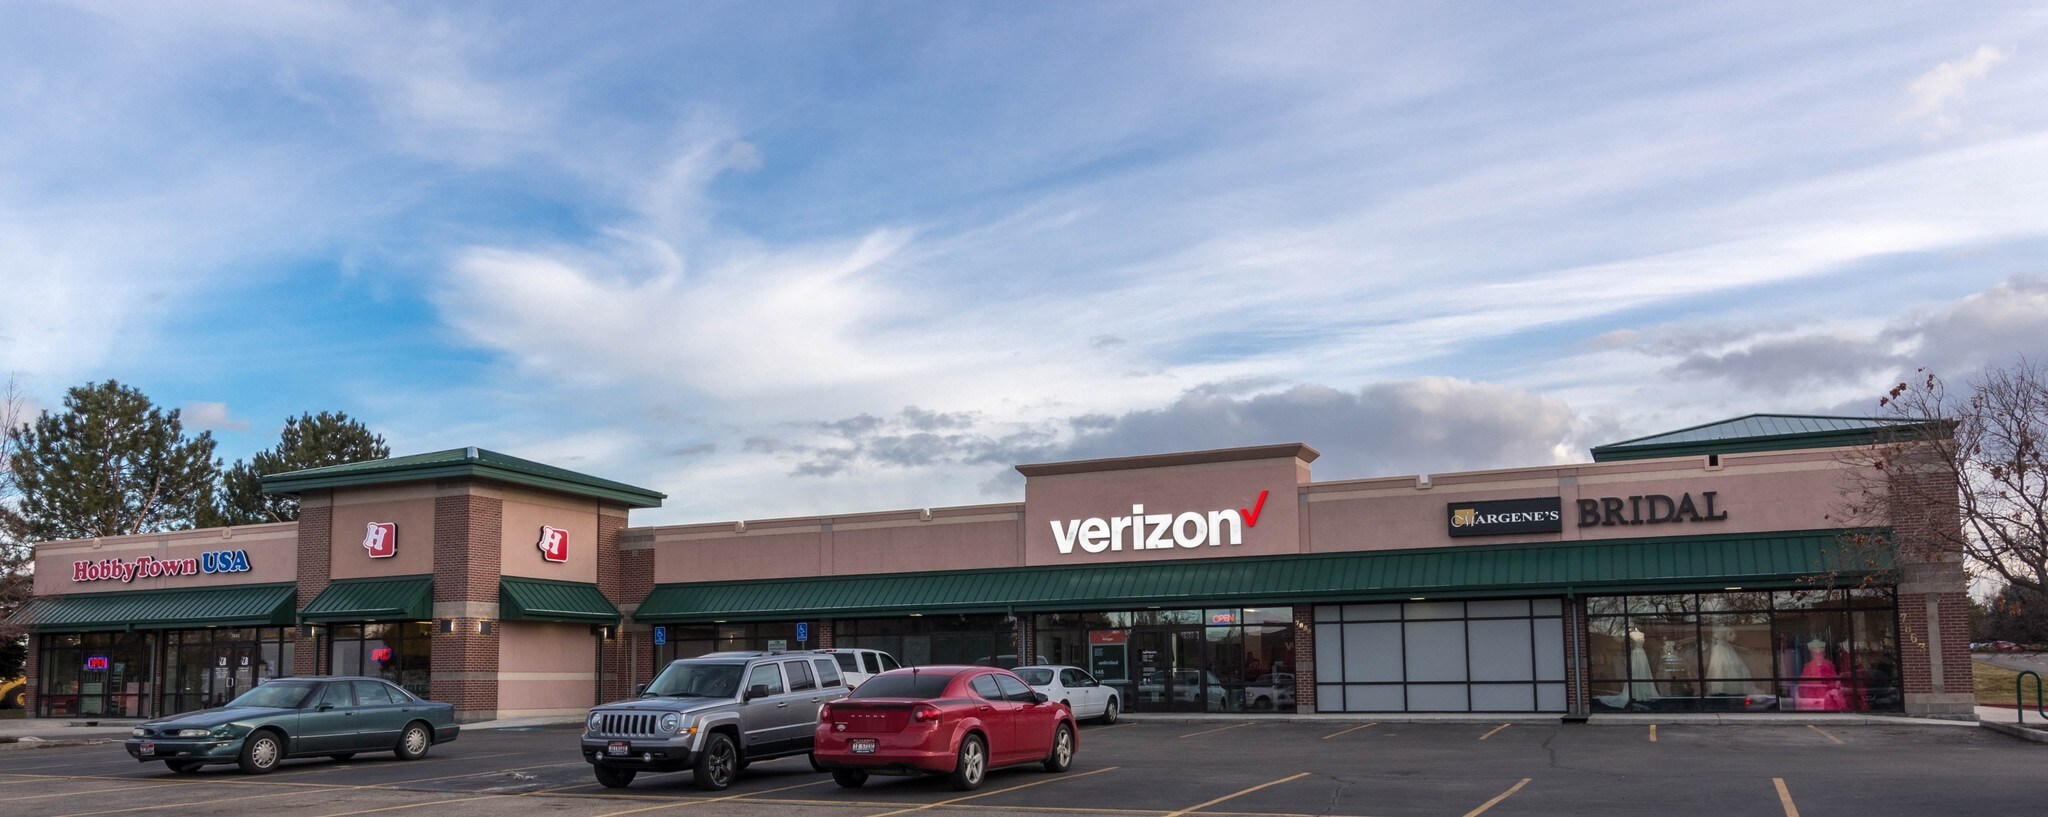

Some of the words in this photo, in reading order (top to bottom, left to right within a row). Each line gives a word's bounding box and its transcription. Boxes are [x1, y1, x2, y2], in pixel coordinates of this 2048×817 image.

[1576, 491, 1728, 527] BRIDAL
[364, 522, 388, 551] H
[540, 526, 563, 555] H
[1050, 503, 1243, 554] verizon
[72, 556, 198, 583] HobbyTown
[201, 550, 251, 574] USA
[1212, 613, 1235, 623] OPEN
